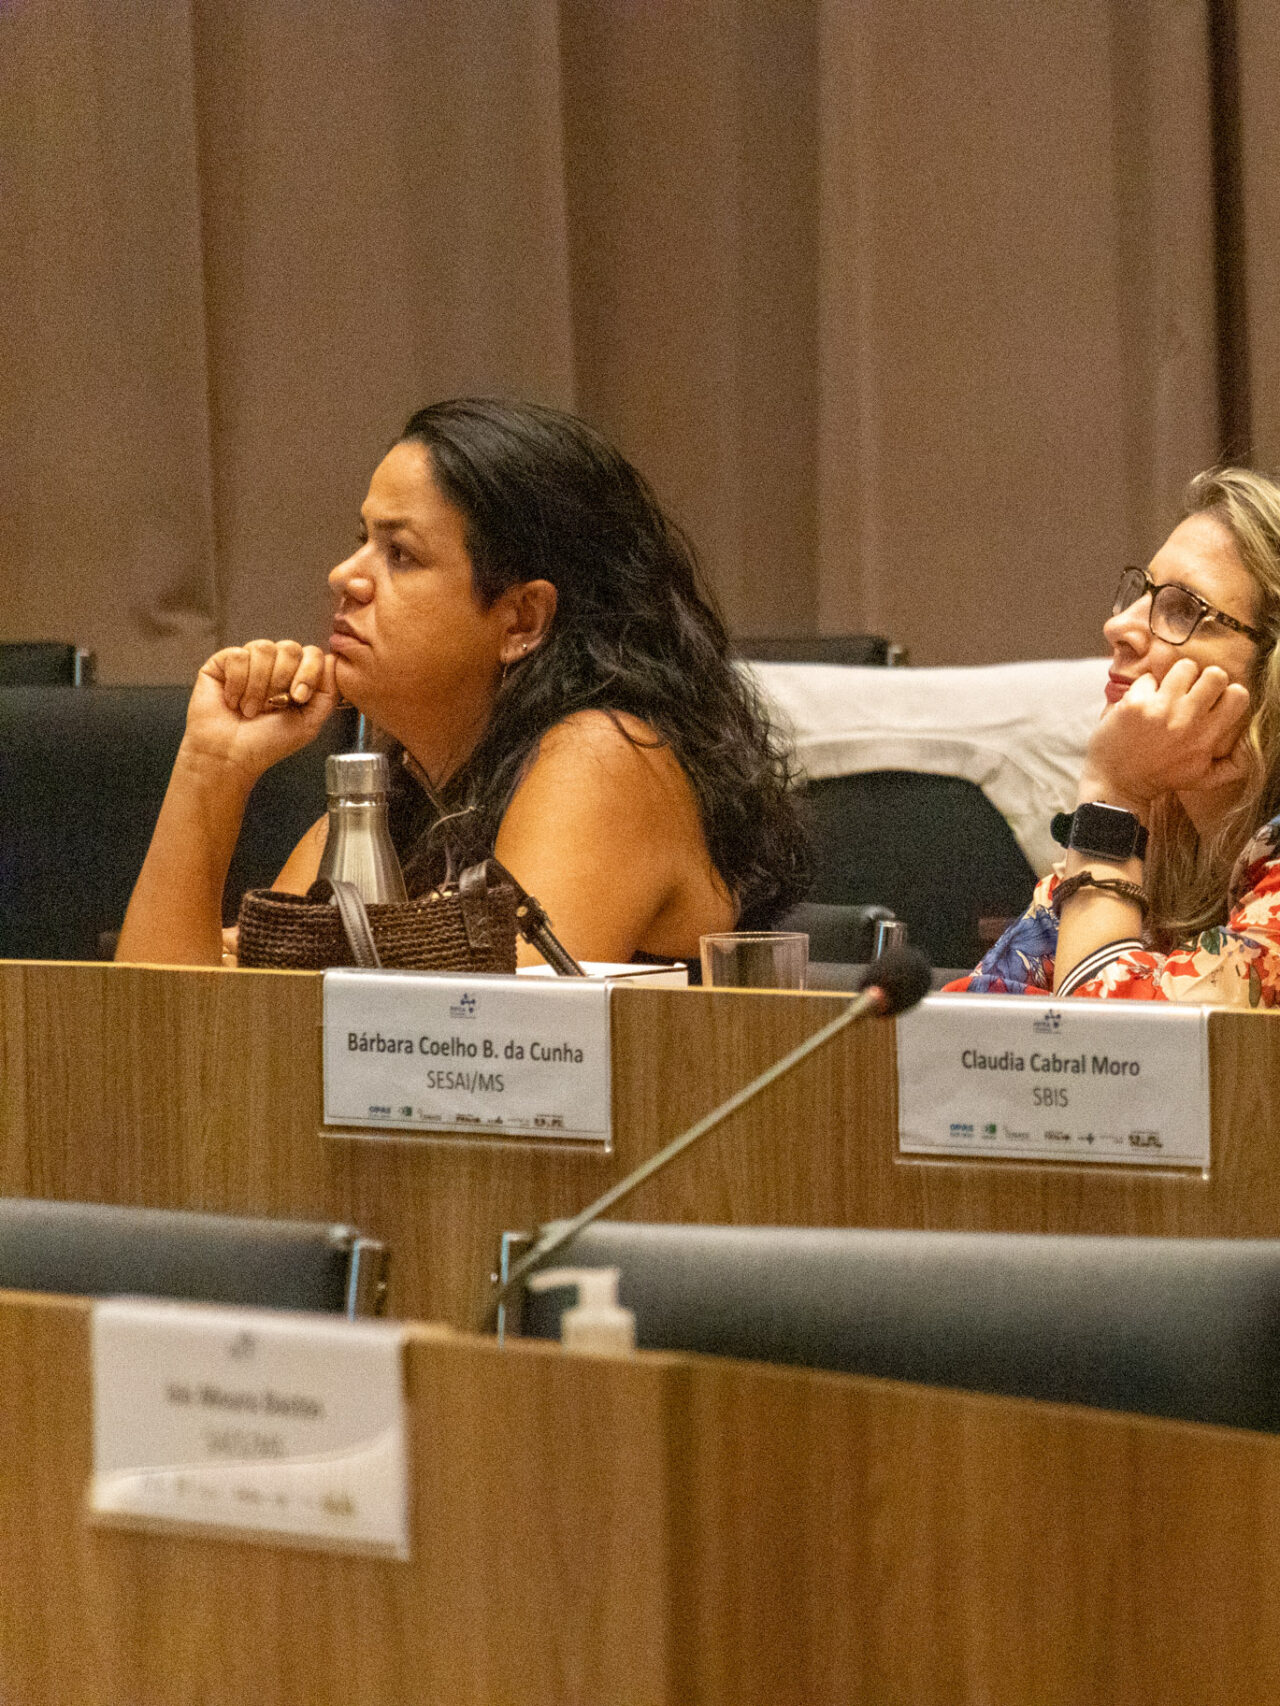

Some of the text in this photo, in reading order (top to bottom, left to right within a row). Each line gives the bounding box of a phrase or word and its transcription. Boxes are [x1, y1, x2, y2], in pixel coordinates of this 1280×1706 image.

[348, 1032, 584, 1063] Bárbara Coelho B. da Cunha
[962, 1050, 1140, 1076] Claudia Cabral Moro
[427, 1070, 504, 1093] SESAI/MS
[1033, 1087, 1069, 1108] SBIS
